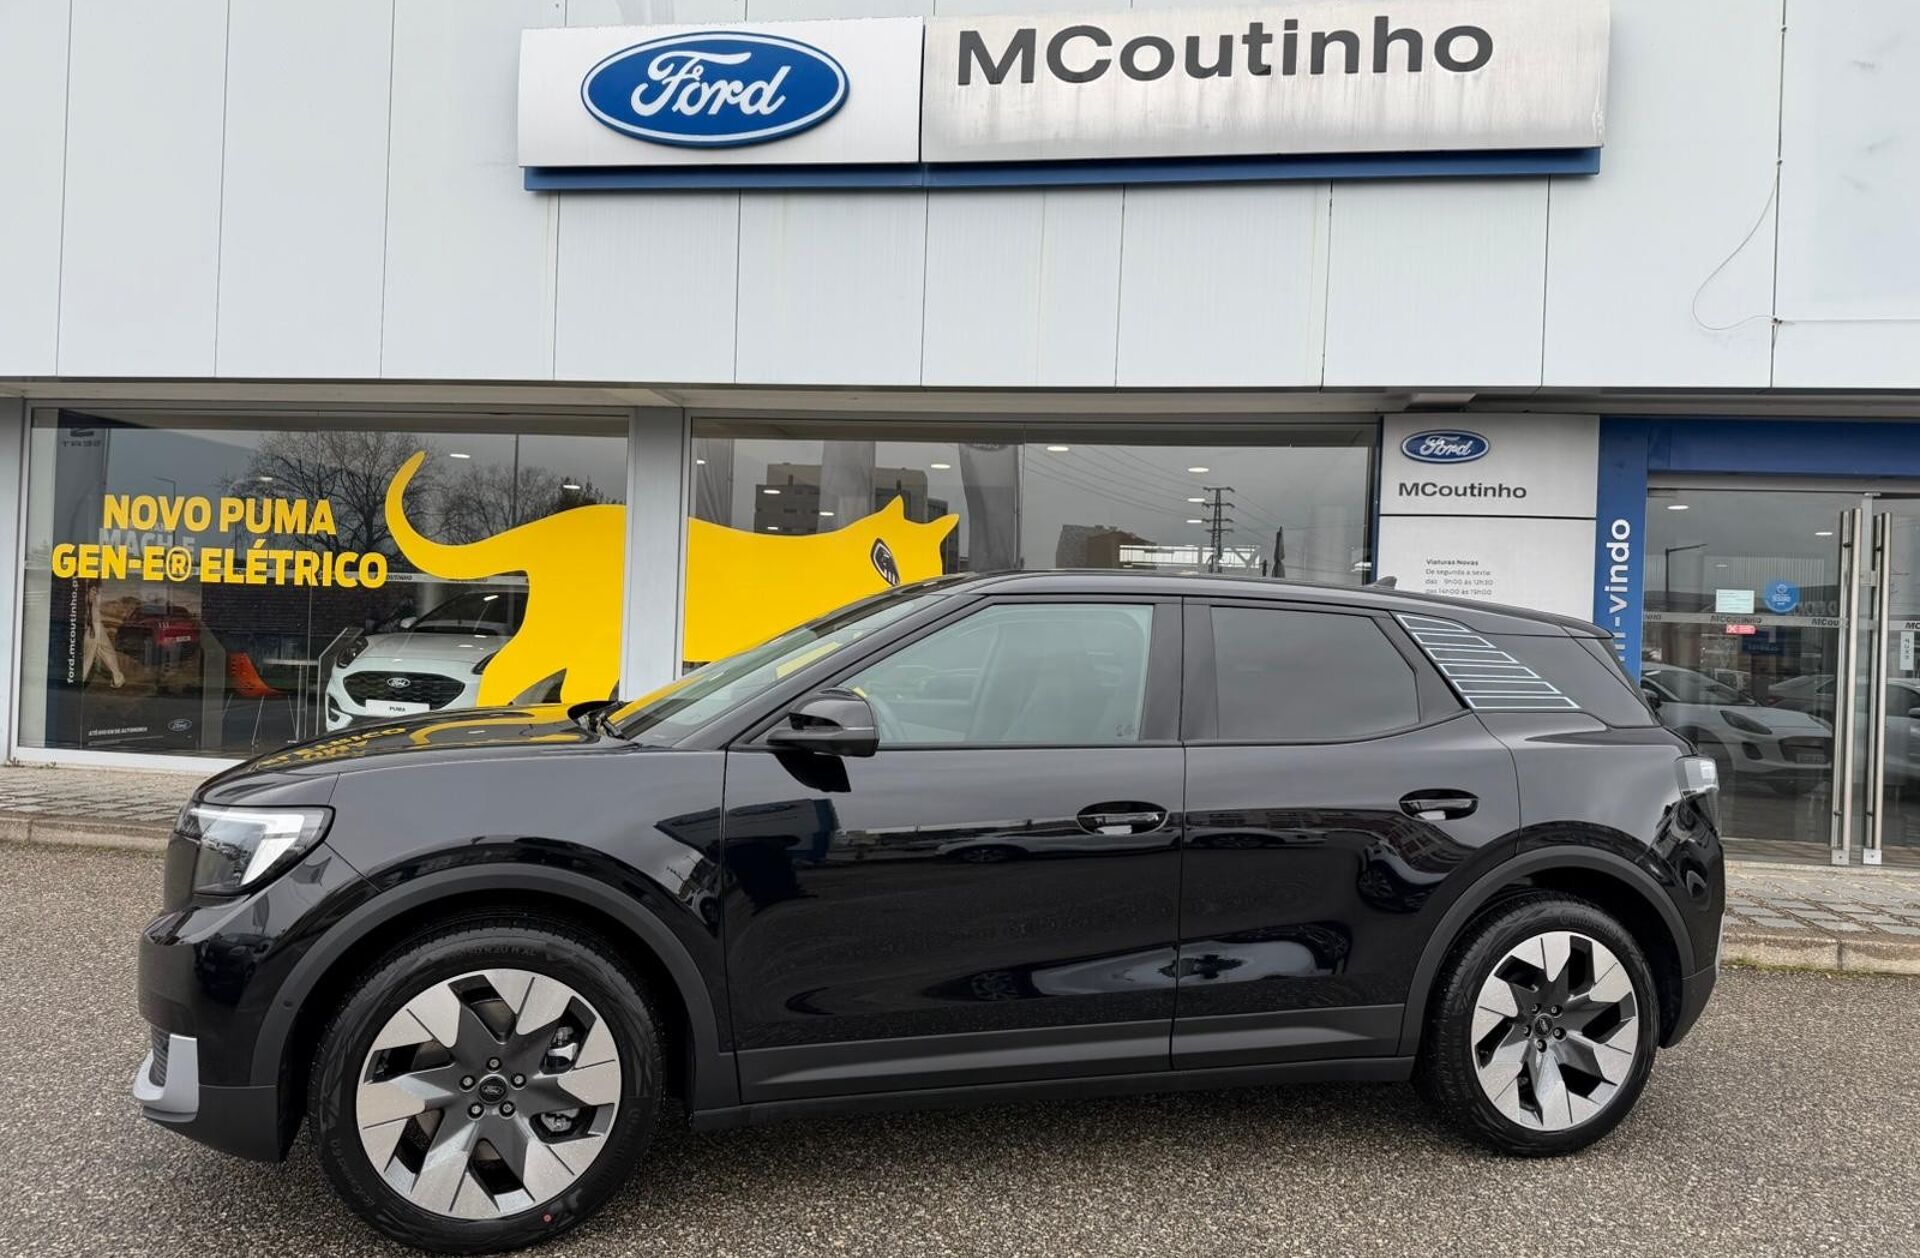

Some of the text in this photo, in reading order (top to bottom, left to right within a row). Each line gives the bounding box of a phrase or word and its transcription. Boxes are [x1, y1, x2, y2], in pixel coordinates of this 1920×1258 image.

[957, 16, 1494, 87] MCoutinho
[631, 51, 791, 117] Ford
[1419, 436, 1473, 456] Ford
[103, 494, 337, 535] NOVO PUMA
[1399, 482, 1527, 499] MCoutinho
[52, 538, 388, 589] GEN-E® ELÉTRICO
[66, 575, 79, 684] ford.mcoutinho.p
